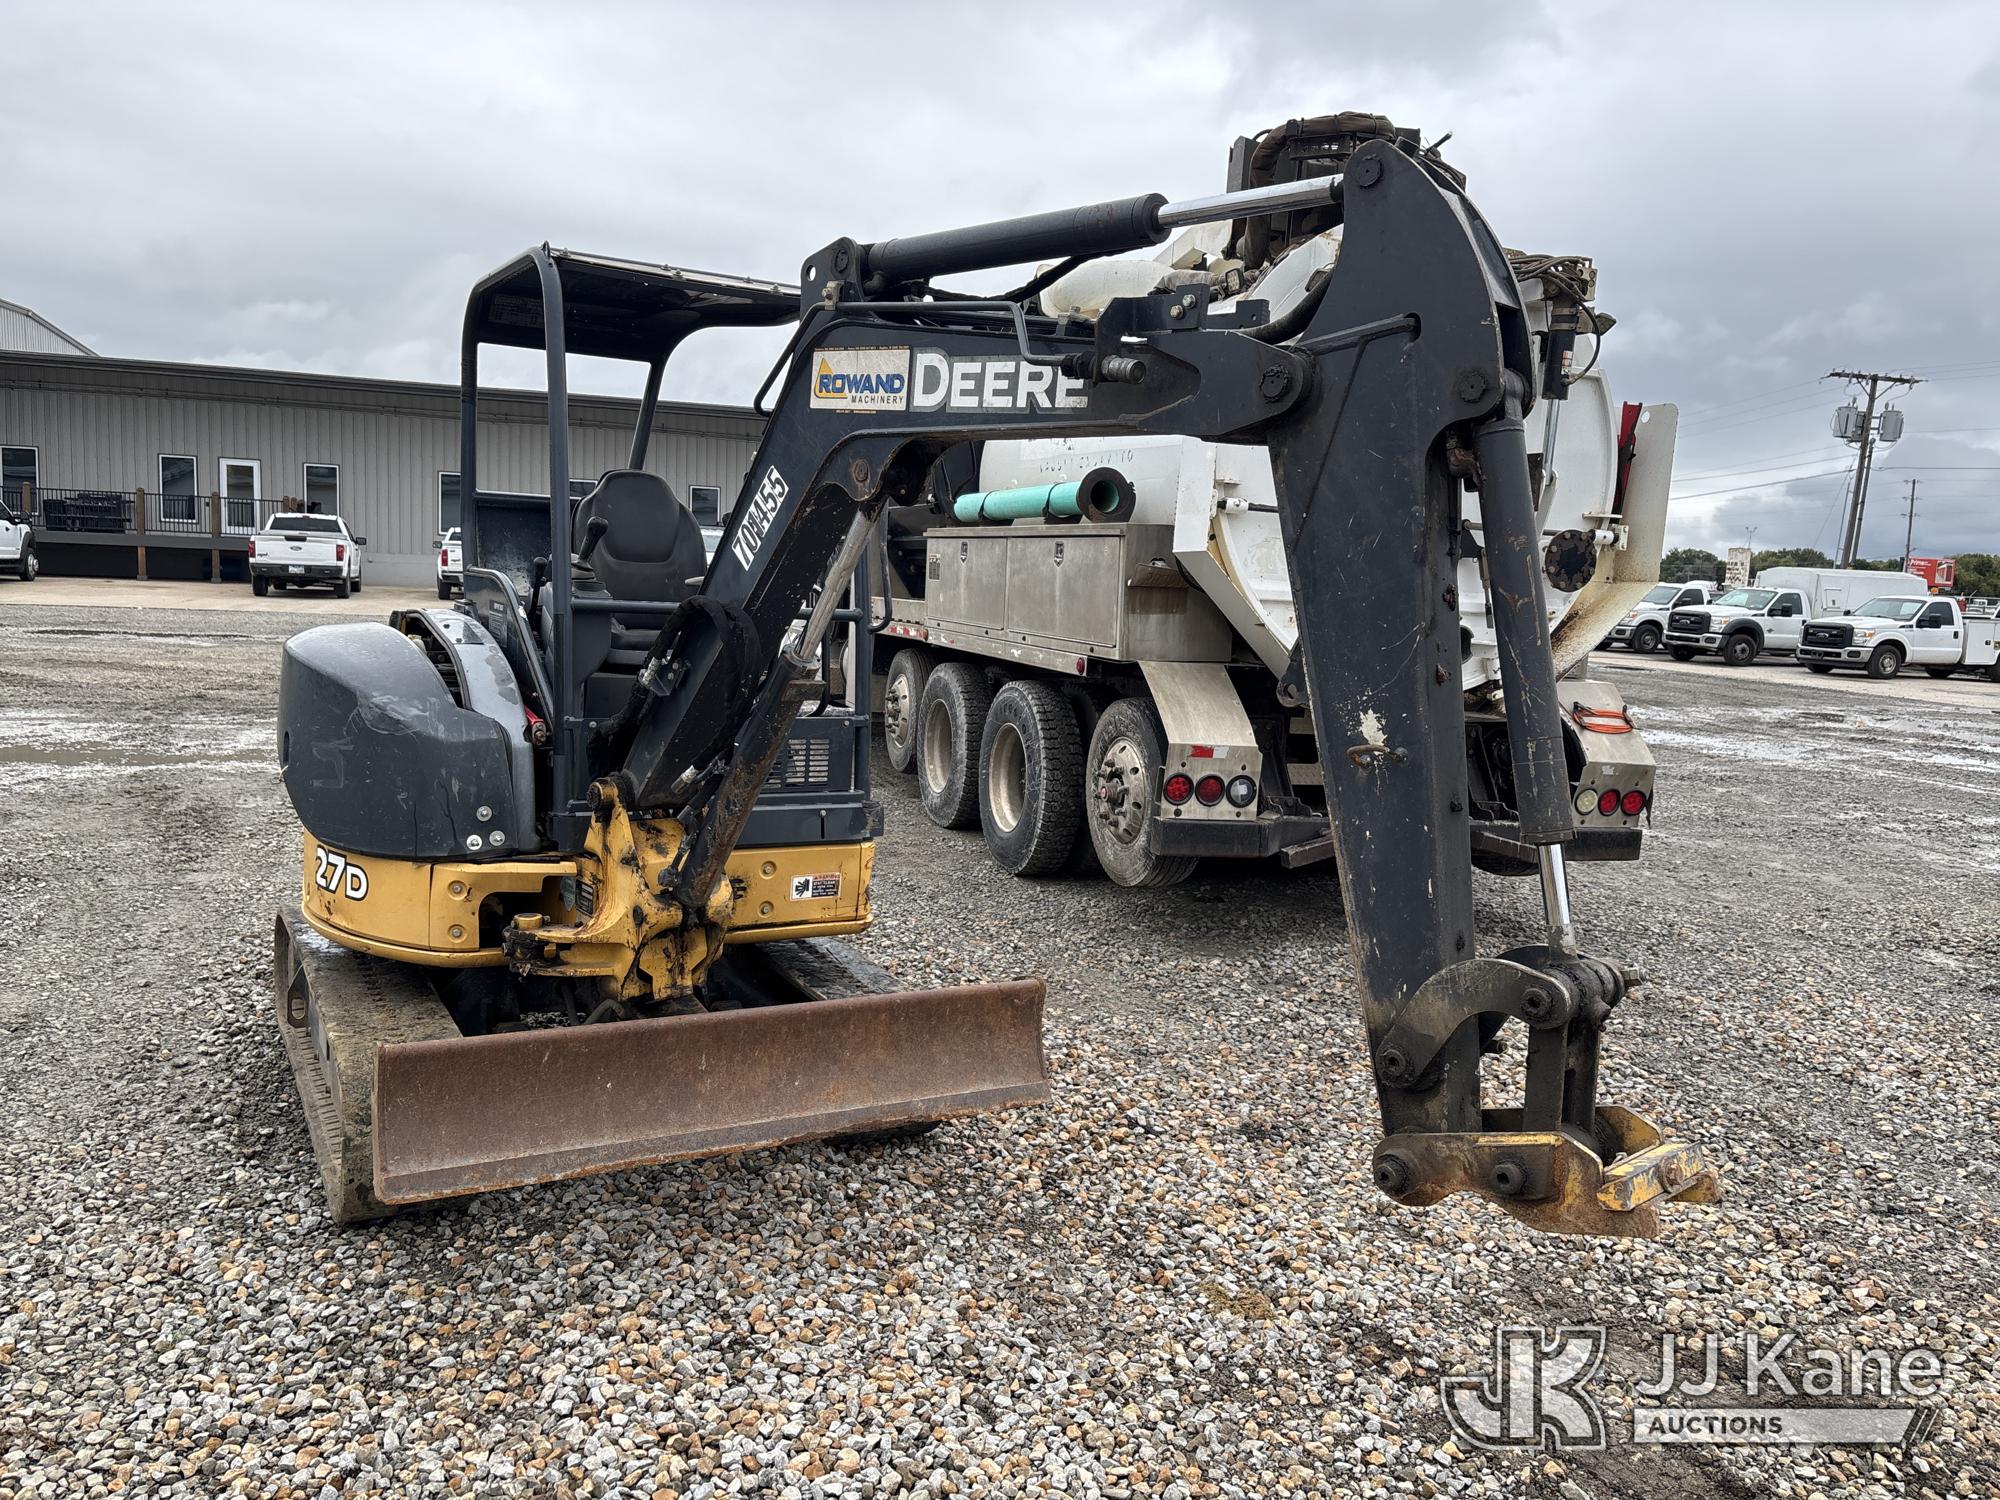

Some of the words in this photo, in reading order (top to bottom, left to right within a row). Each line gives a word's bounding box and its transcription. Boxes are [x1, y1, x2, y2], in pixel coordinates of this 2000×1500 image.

[818, 373, 906, 394] ROWAND
[851, 395, 904, 405] MACHINERY
[914, 353, 1089, 408] DEERE
[732, 466, 788, 570] 701455
[315, 845, 369, 901] 27D
